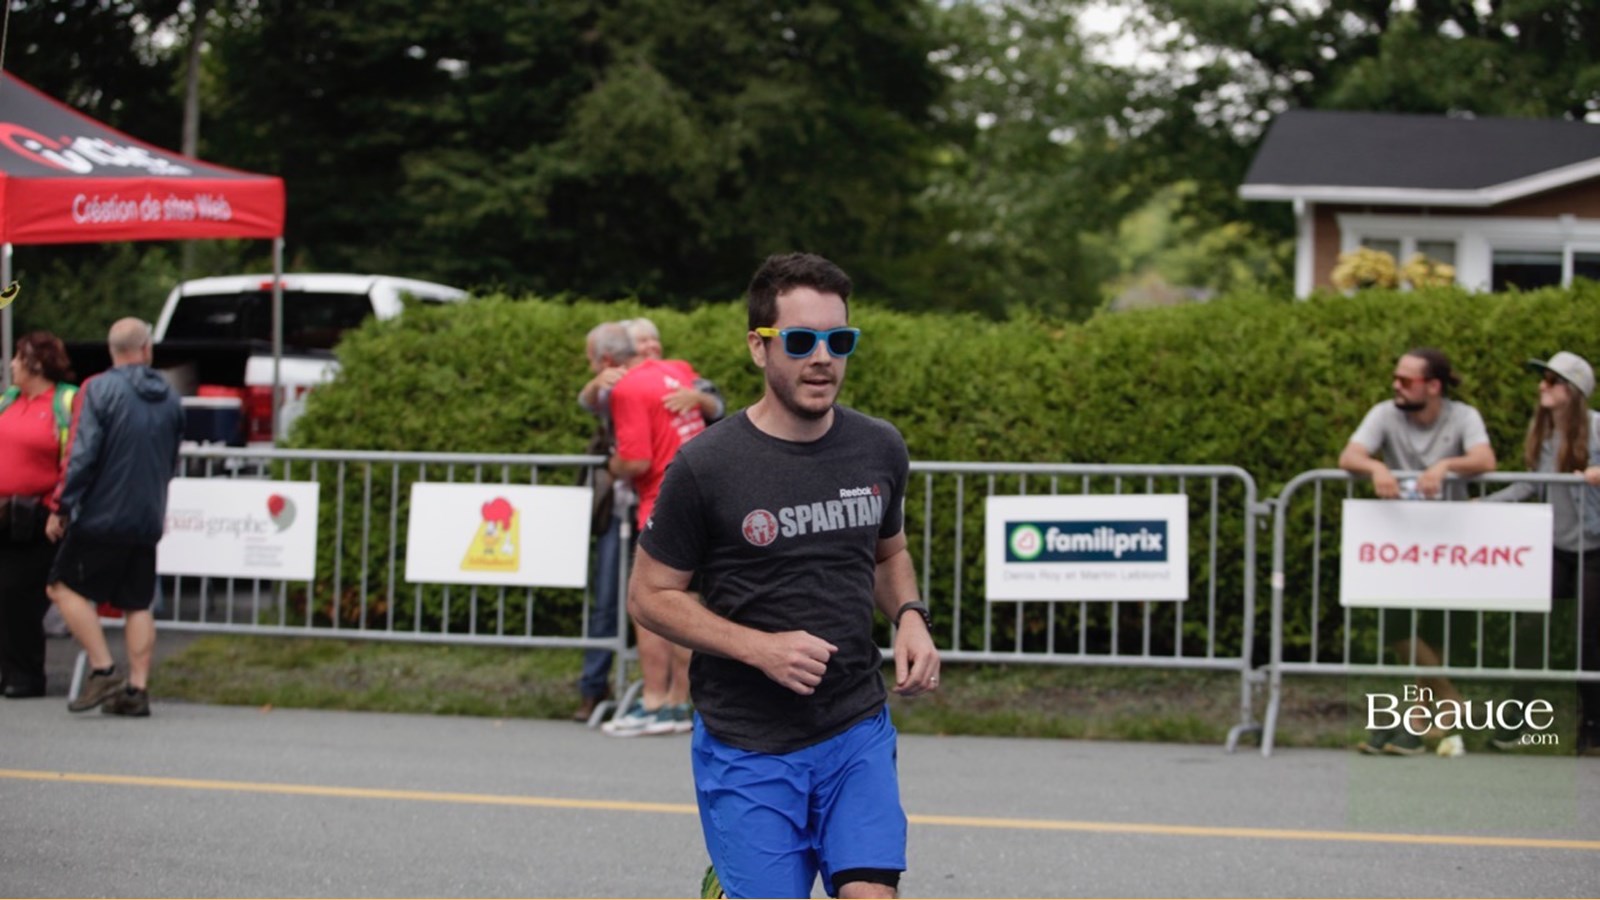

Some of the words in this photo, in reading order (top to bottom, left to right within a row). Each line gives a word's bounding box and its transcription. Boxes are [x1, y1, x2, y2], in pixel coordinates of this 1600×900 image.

[140, 194, 162, 222] de
[839, 486, 872, 499] Reebok
[778, 495, 883, 539] SPARTAN
[1045, 525, 1163, 559] familiprix
